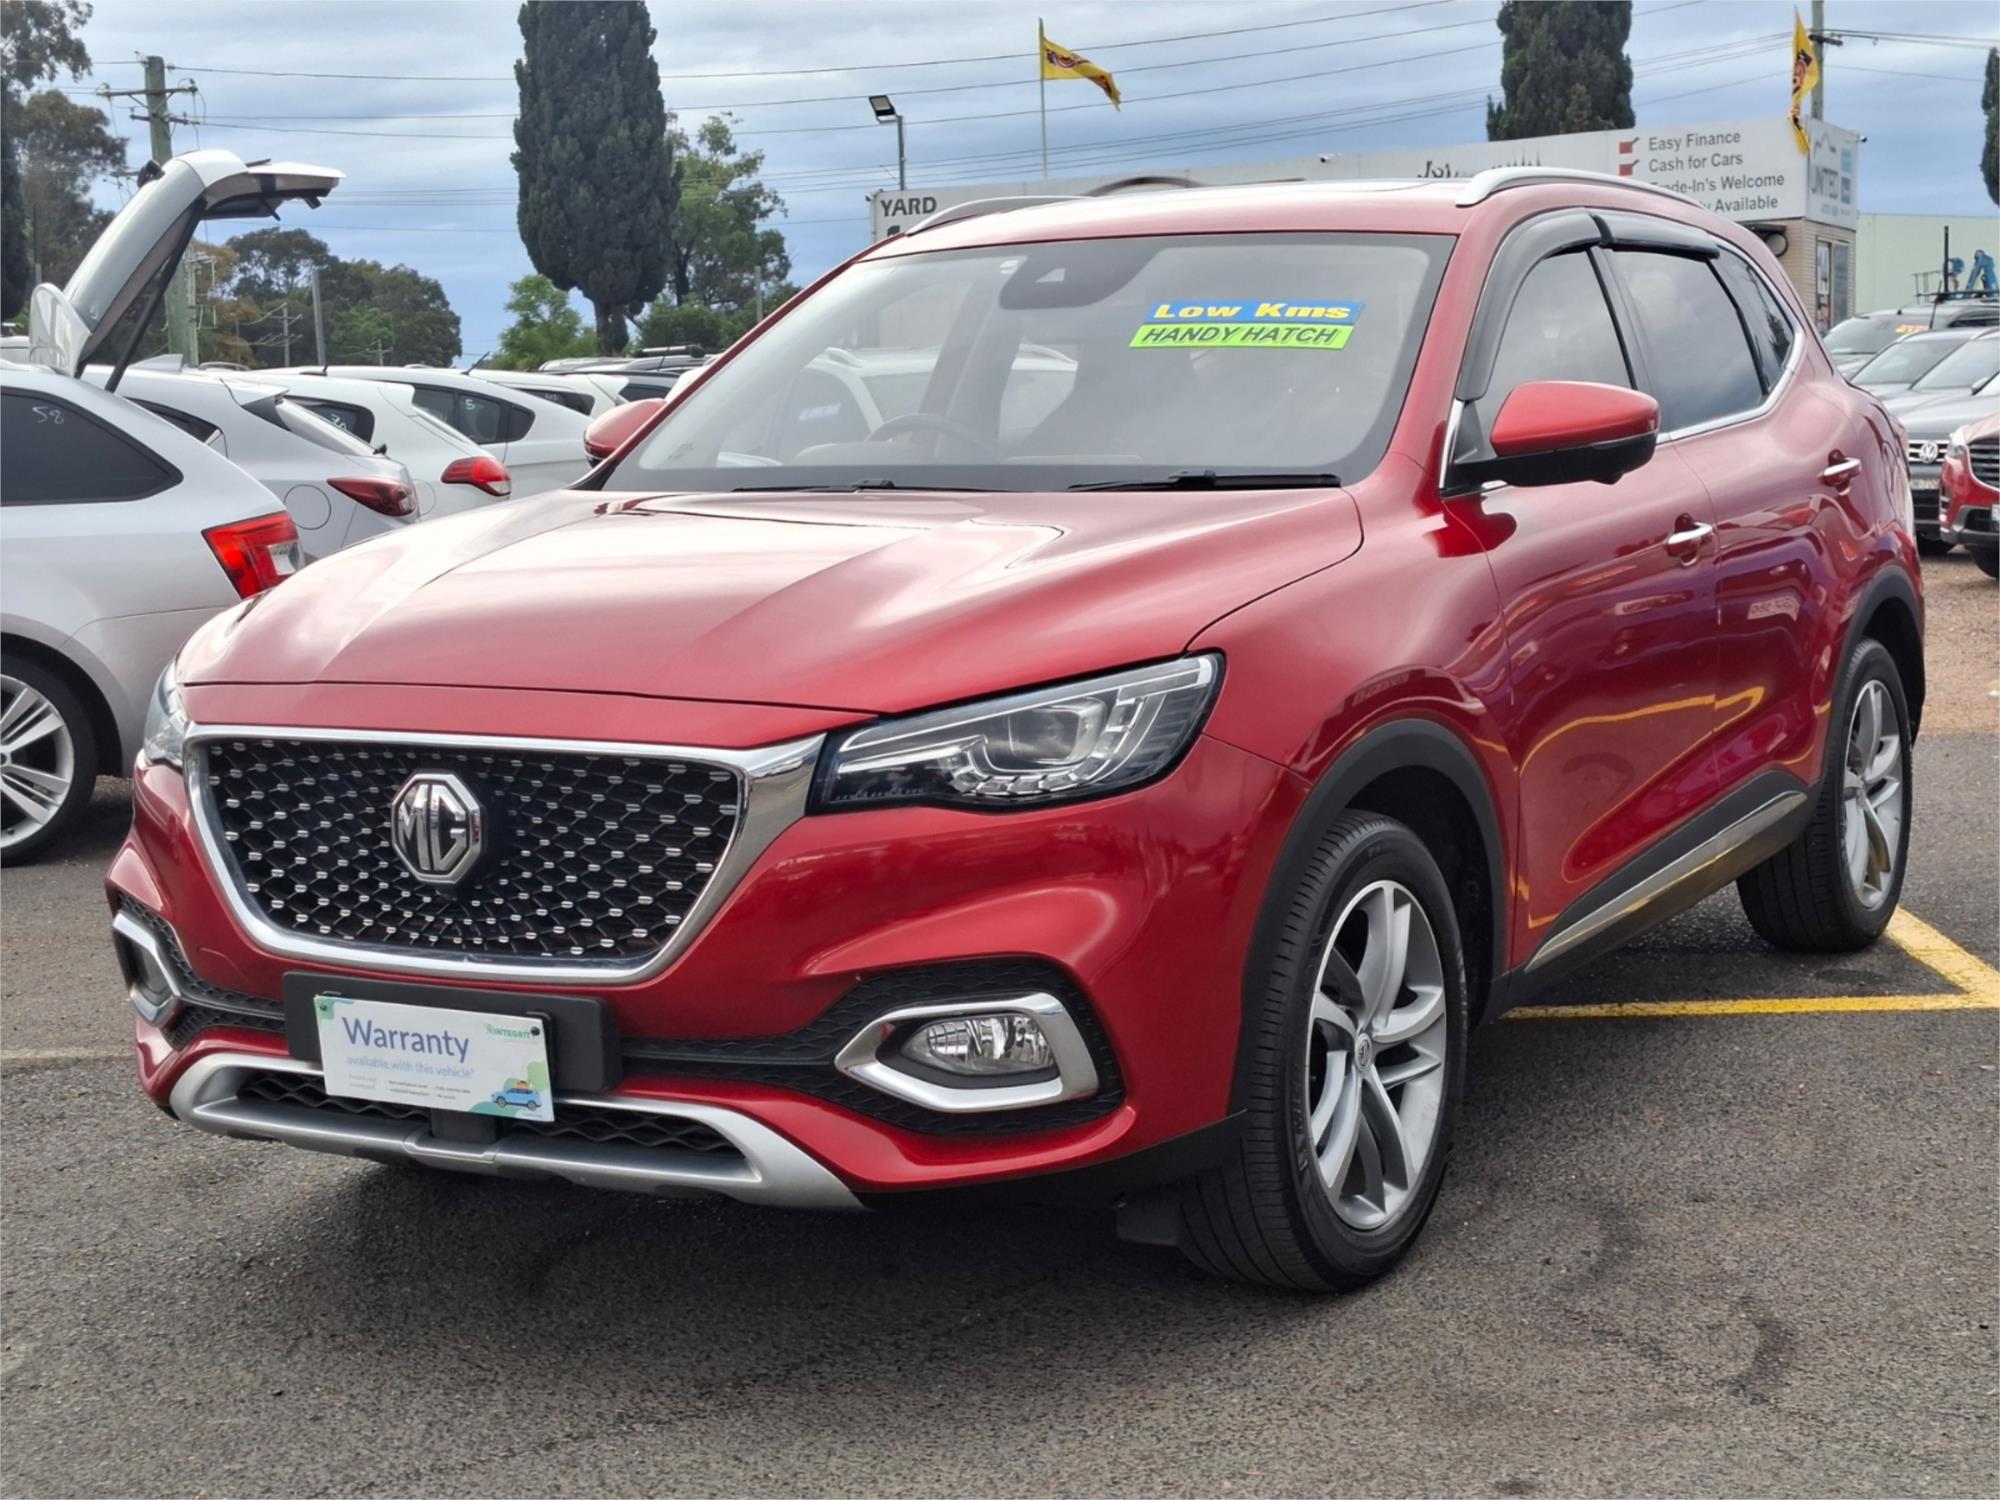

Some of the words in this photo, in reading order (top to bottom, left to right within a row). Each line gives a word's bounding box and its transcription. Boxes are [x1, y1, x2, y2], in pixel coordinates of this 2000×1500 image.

[1649, 136, 1681, 152] Easy
[1686, 131, 1741, 147] Finance
[1649, 158, 1683, 173] Cash
[1688, 154, 1707, 169] for
[1711, 152, 1743, 167] Cars
[1650, 177, 1717, 193] de-In's
[1721, 173, 1785, 191] Welcome
[880, 196, 937, 217] YARD
[1714, 195, 1778, 213] Available
[1153, 304, 1242, 318] Low
[1254, 303, 1351, 318] Kms
[1142, 327, 1240, 344] HANDY
[1240, 328, 1341, 344] HATCH
[398, 784, 467, 871] MG
[342, 1016, 469, 1064] Warranty
[347, 1055, 390, 1070] available
[391, 1059, 414, 1073] with
[415, 1061, 434, 1075] this
